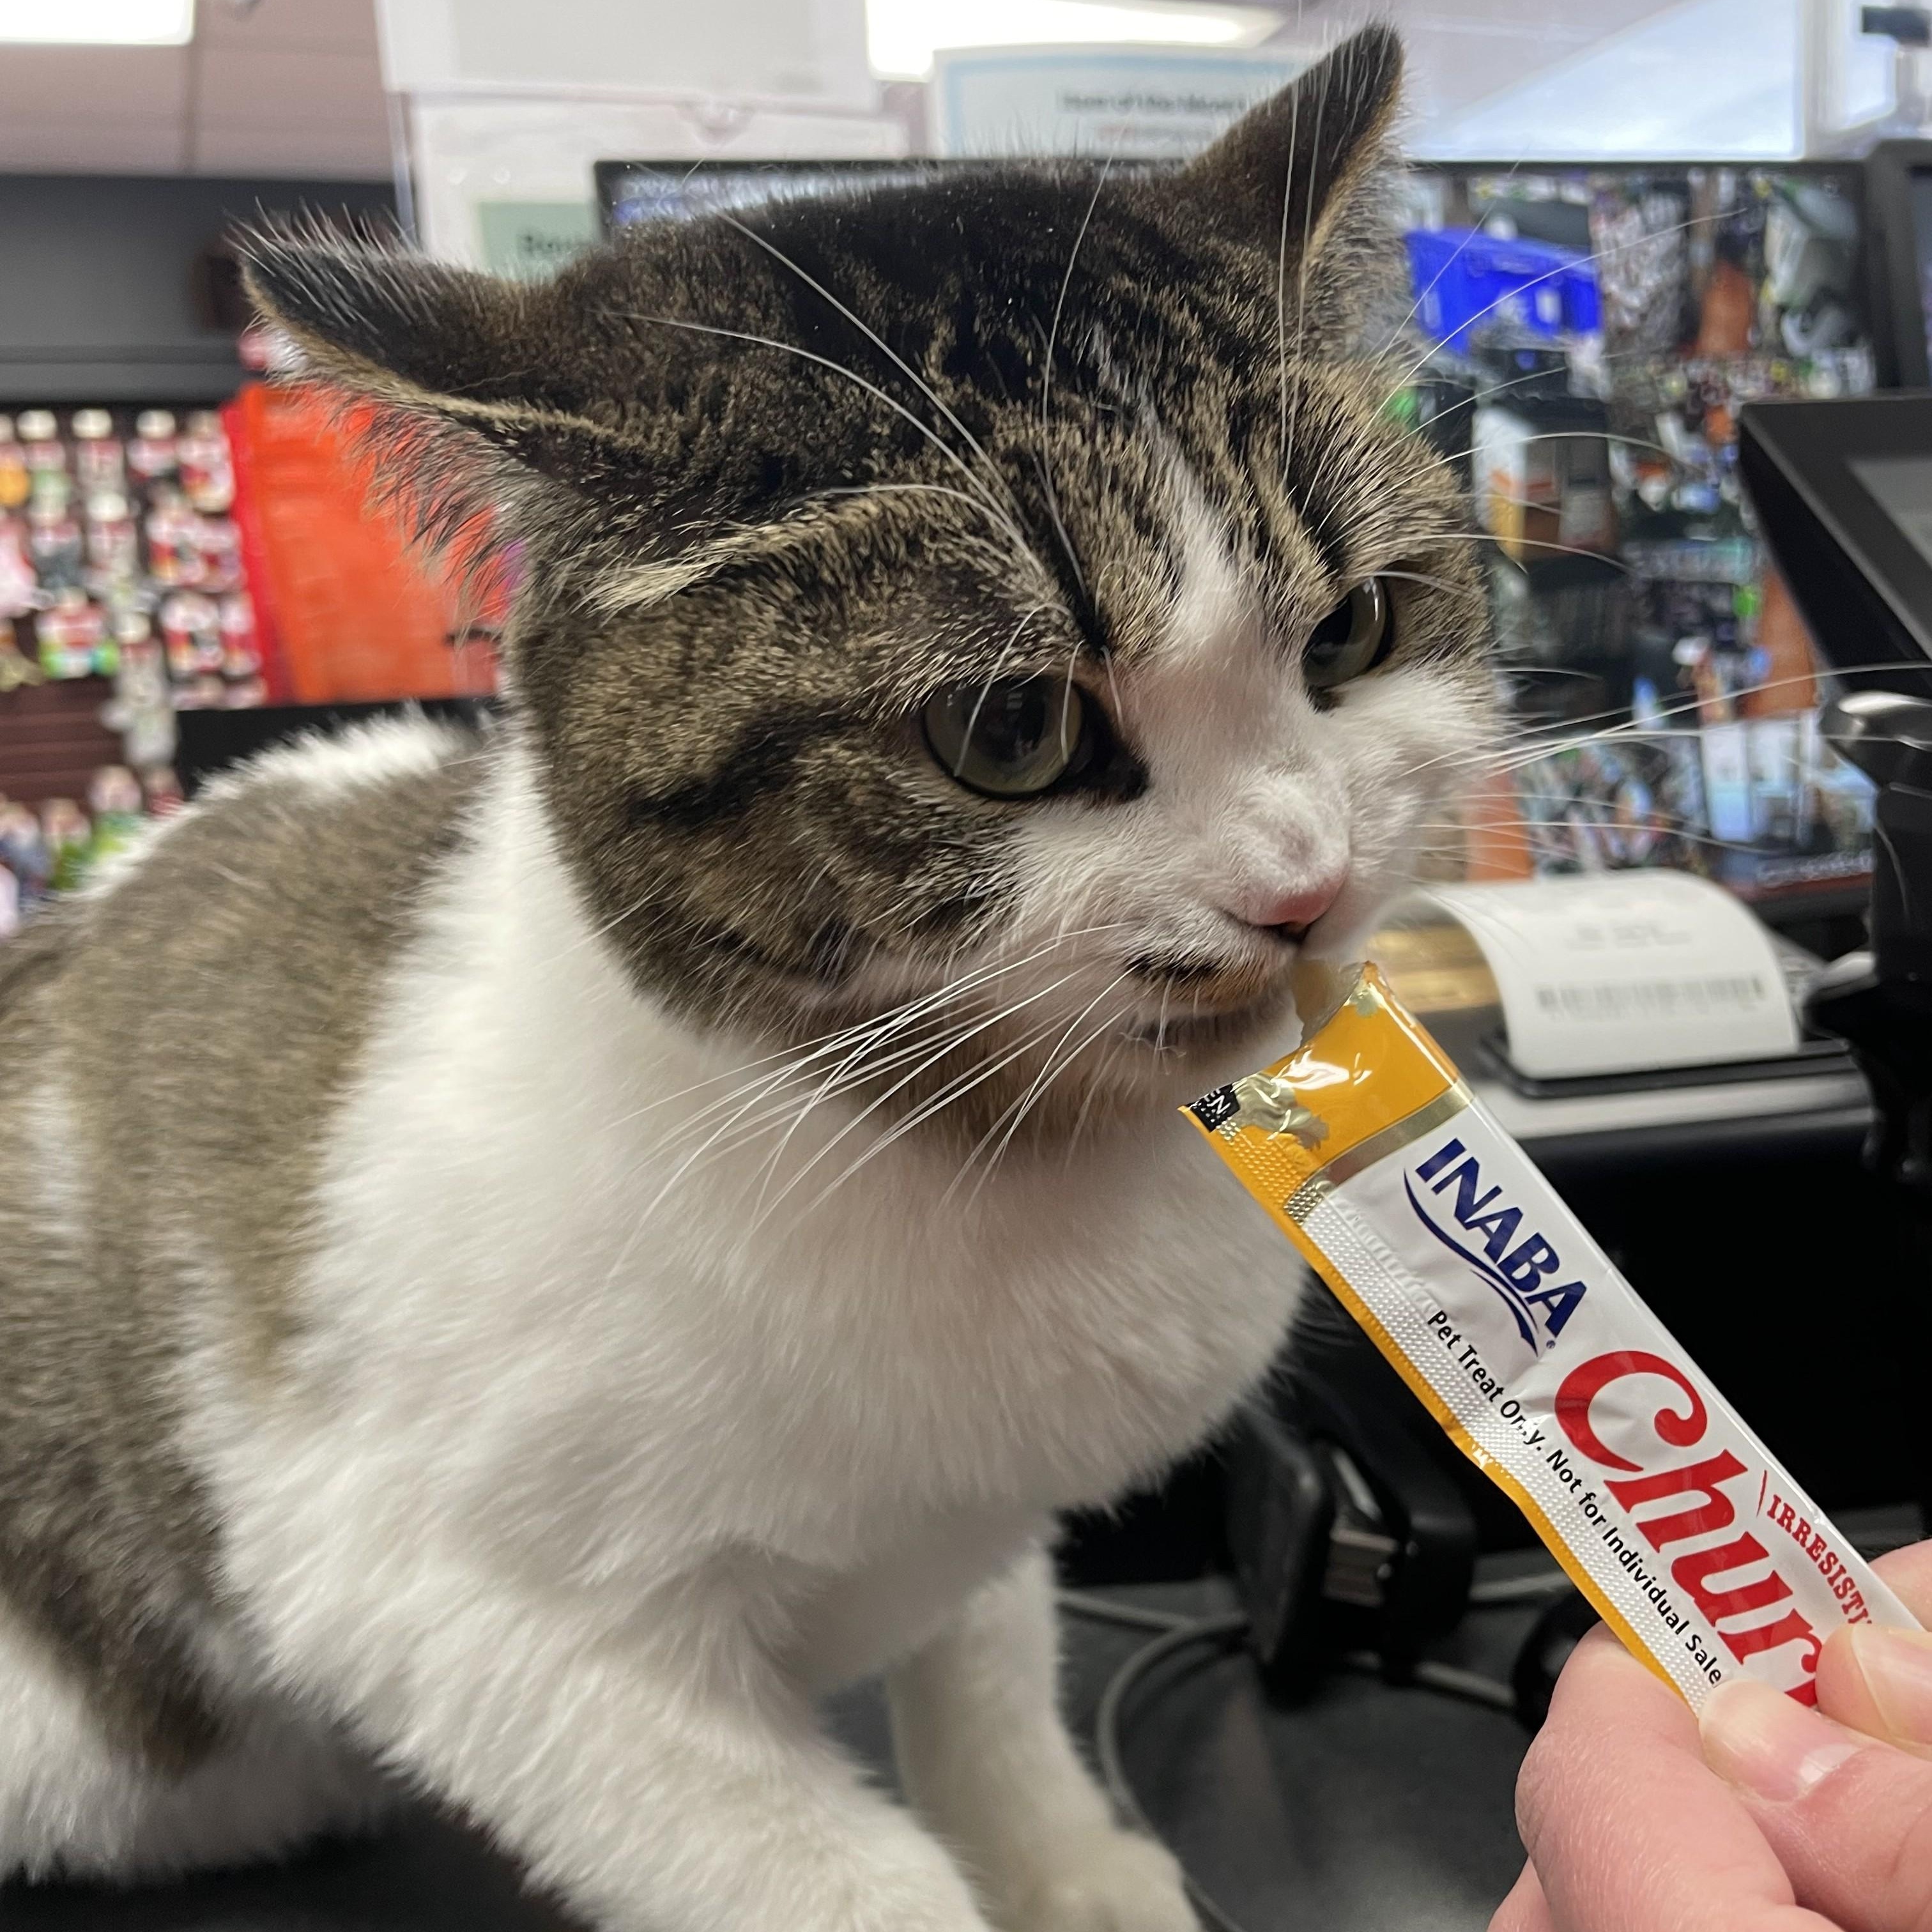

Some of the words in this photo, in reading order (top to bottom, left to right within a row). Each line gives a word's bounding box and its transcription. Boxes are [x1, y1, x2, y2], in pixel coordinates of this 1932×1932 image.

[1415, 1138, 1588, 1337] INABA
[1427, 1310, 1461, 1349] Pet
[1458, 1344, 1504, 1402] Treat
[1500, 1400, 1546, 1451] Ony.
[1546, 1449, 1582, 1494] Not
[1578, 1492, 1606, 1526] for
[1602, 1527, 1689, 1635] Individual
[1685, 1634, 1722, 1685] Sale
[1554, 1351, 1822, 1707] Chur
